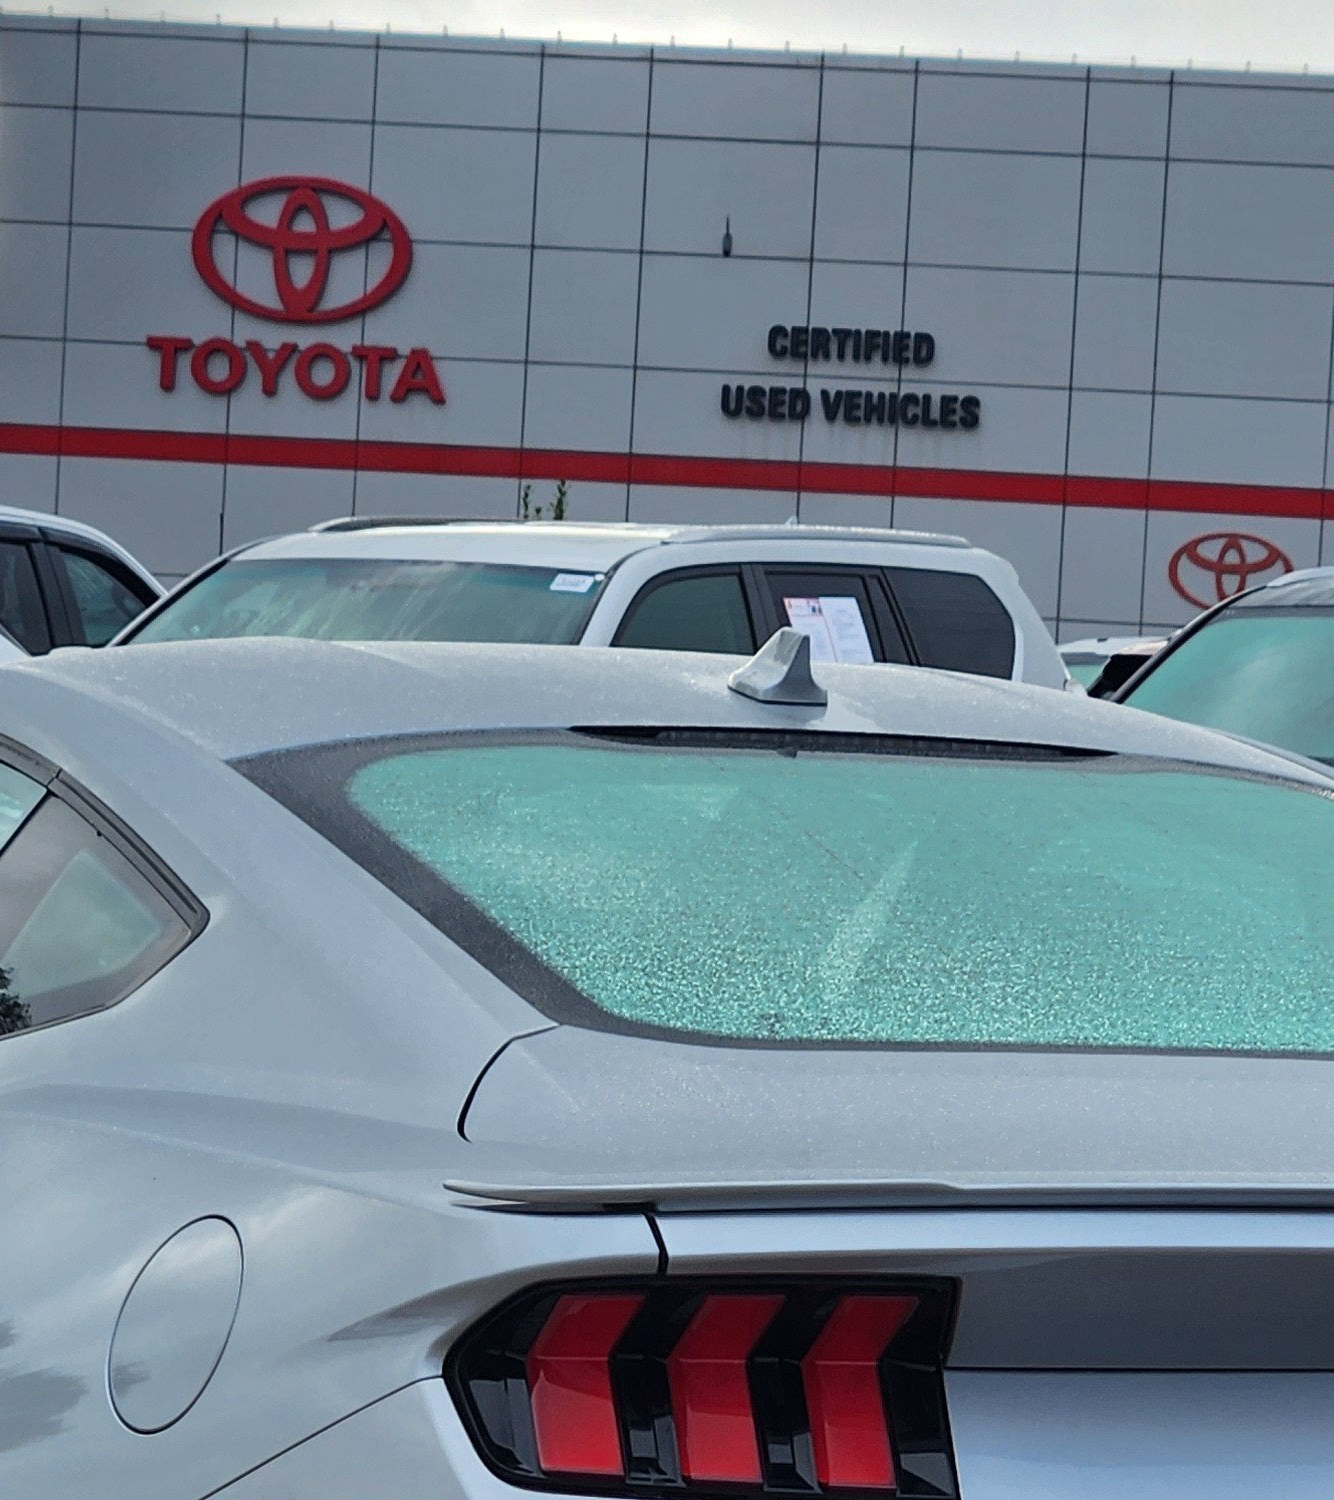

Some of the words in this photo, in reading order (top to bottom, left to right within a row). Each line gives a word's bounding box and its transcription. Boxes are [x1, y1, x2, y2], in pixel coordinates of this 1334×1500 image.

[767, 324, 935, 366] CERTIFIED
[146, 334, 447, 405] TOYOTA
[720, 383, 812, 421] USED
[820, 388, 981, 429] VEHICLES
